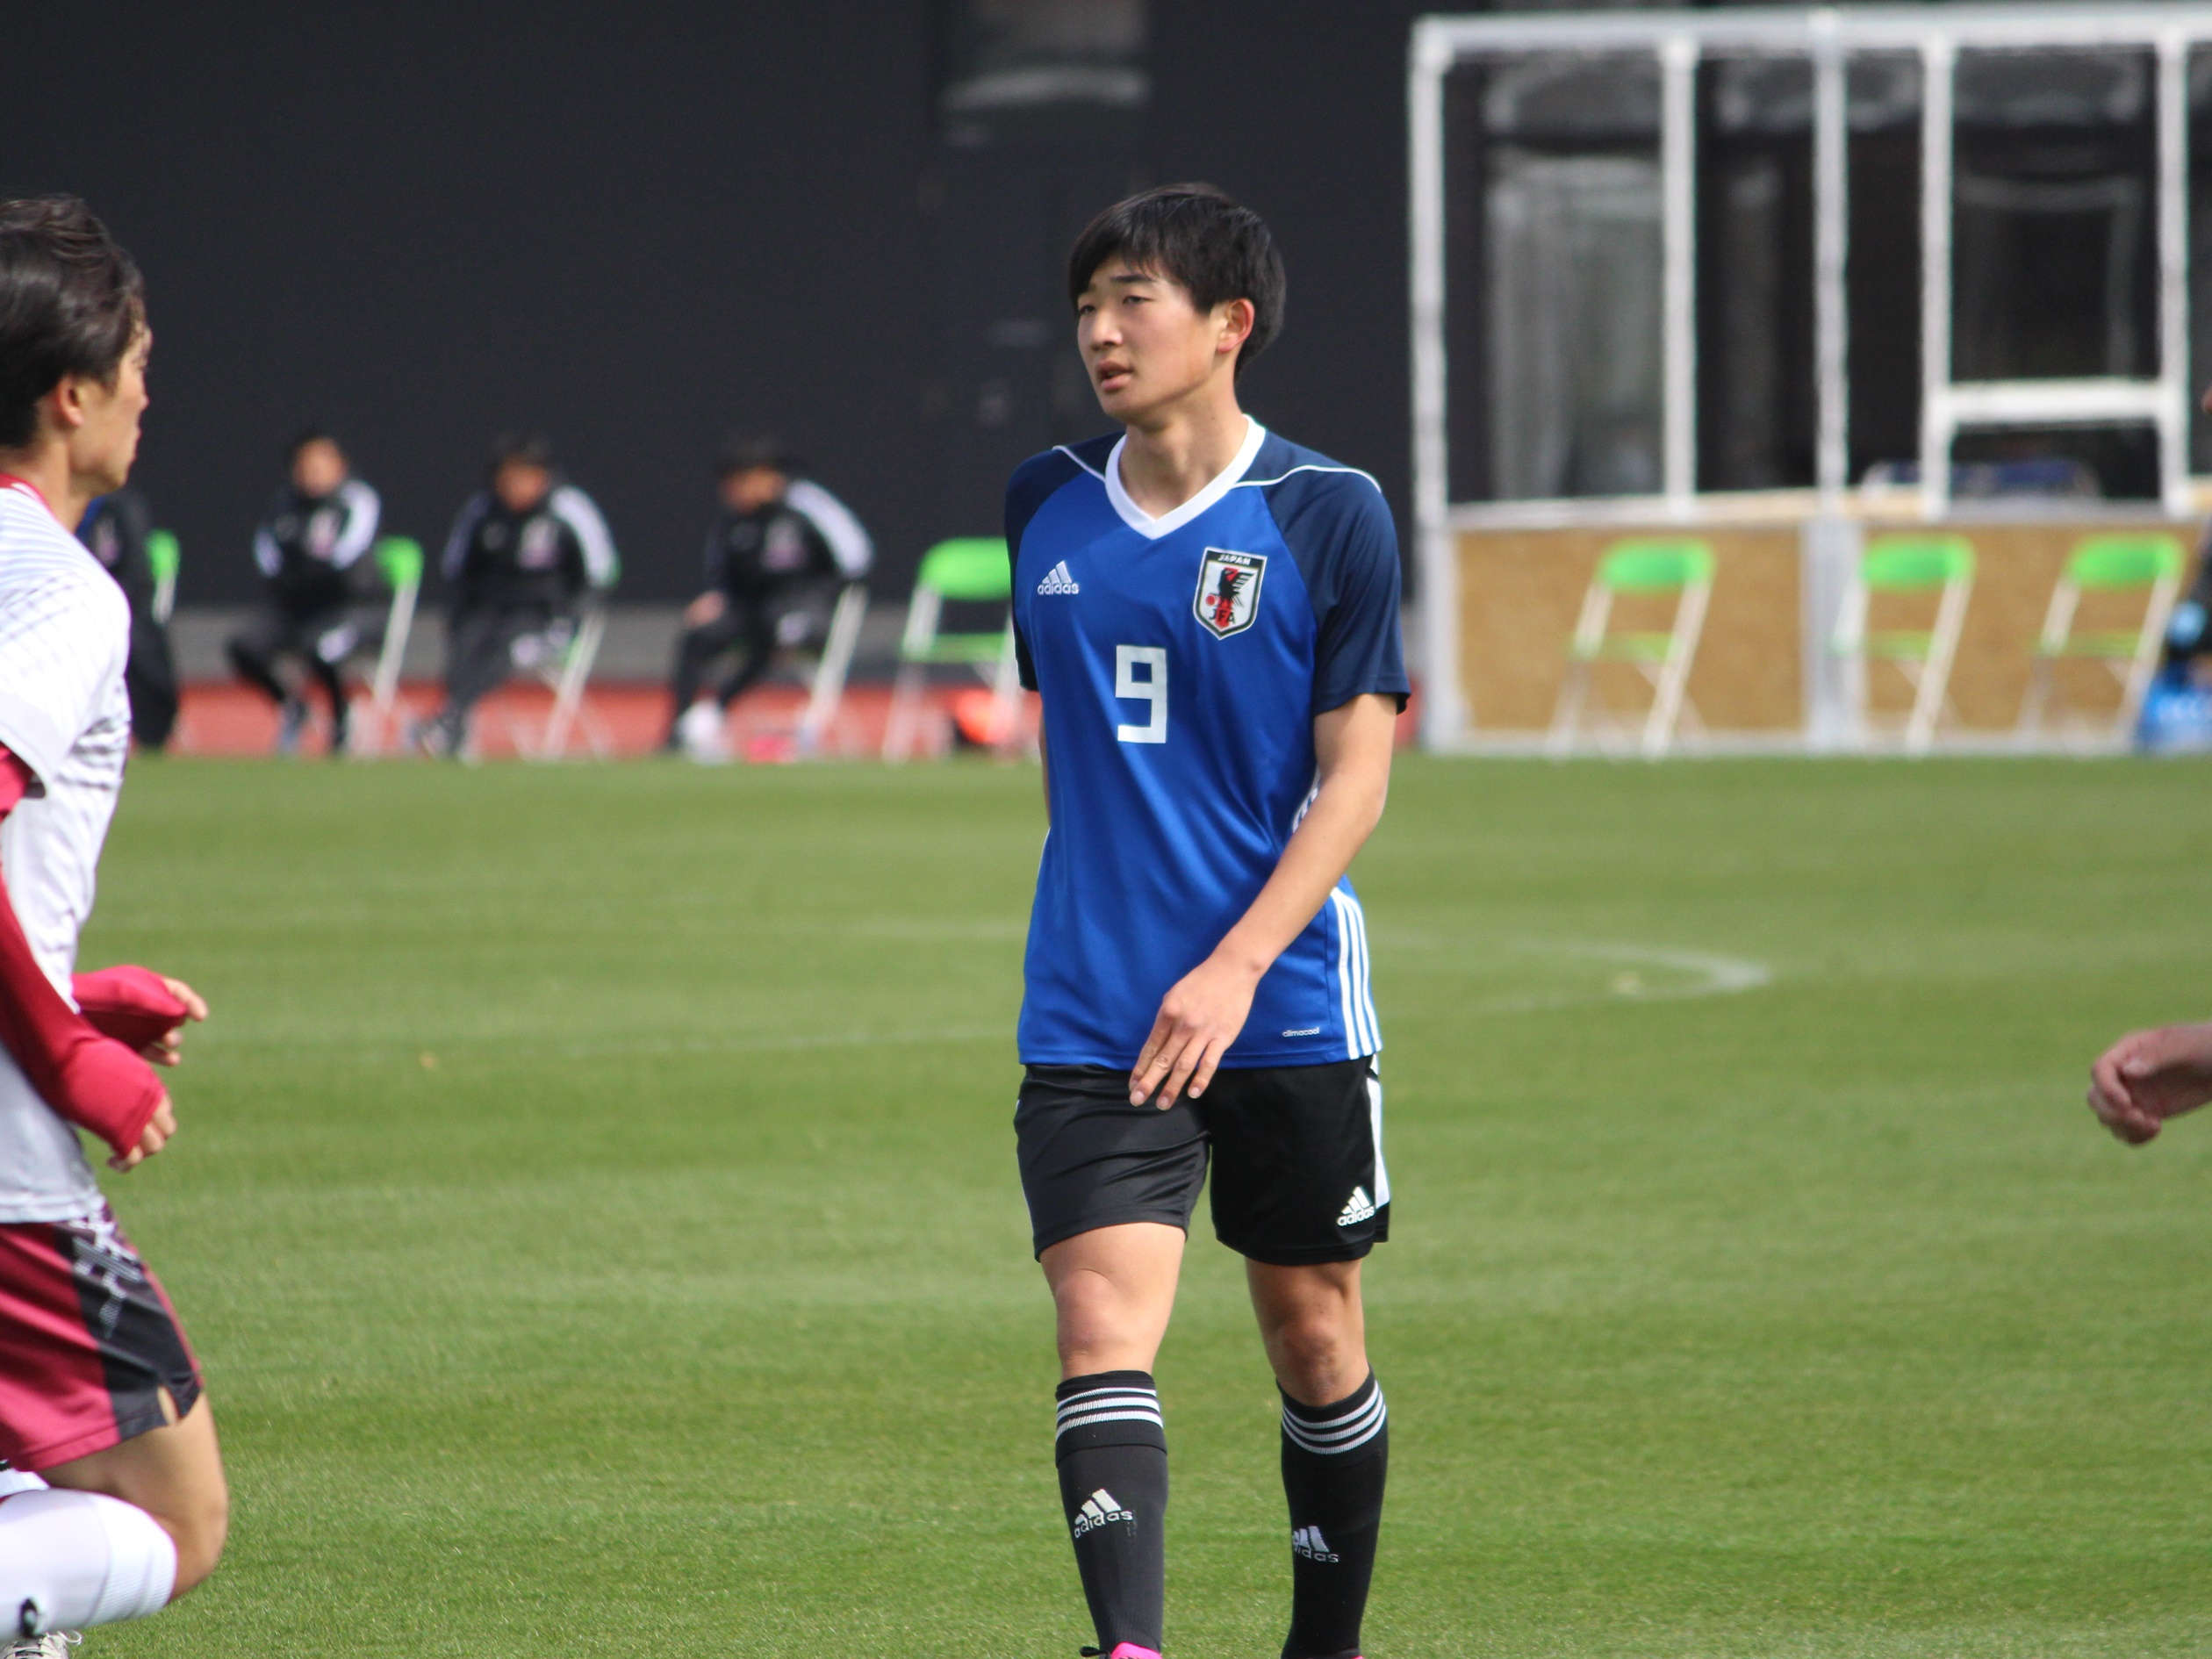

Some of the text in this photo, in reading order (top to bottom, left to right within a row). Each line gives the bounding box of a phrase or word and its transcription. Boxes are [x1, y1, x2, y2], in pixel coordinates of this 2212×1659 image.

[1217, 554, 1251, 565] JAPAN
[1037, 583, 1080, 595] adidas
[1209, 608, 1235, 624] JFA
[1116, 645, 1167, 743] 9
[1282, 1027, 1320, 1038] climacool
[1336, 1206, 1375, 1226] adidas
[1074, 1511, 1133, 1539] adidas
